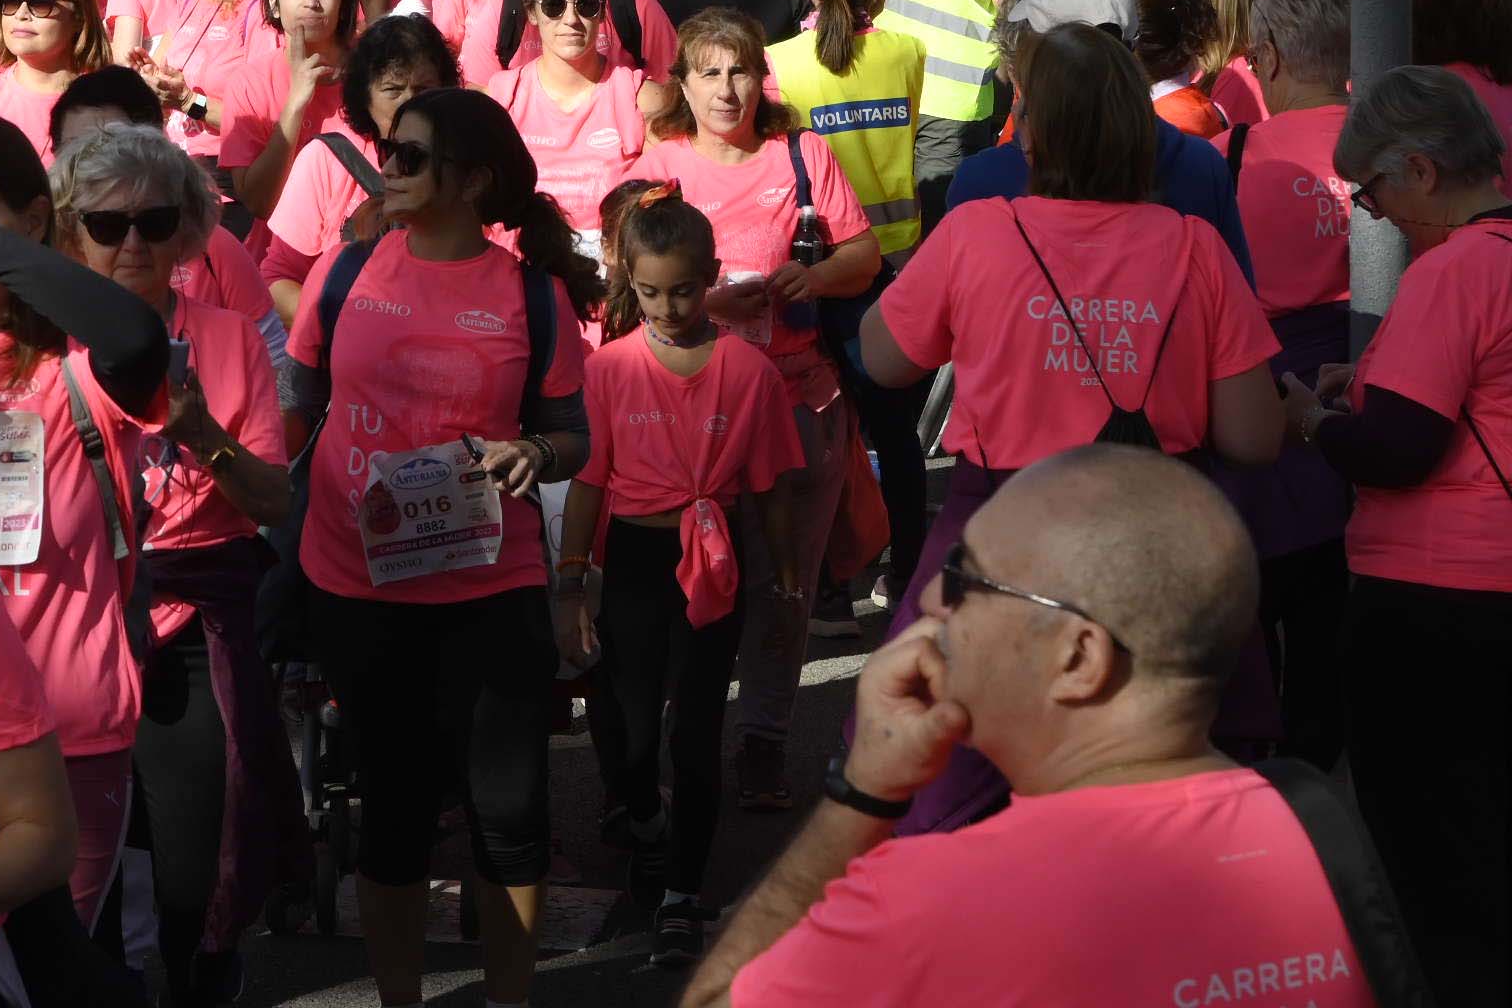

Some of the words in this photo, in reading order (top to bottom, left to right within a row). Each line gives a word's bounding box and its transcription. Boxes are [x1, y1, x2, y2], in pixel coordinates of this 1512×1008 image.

[812, 104, 908, 132] VOLUNTARIS
[354, 297, 412, 318] OYSHO
[1026, 295, 1160, 325] CARRERA
[1096, 325, 1134, 350] LA
[1043, 347, 1139, 374] MUJER
[348, 403, 383, 434] TU
[403, 495, 452, 519] 016
[416, 519, 447, 534] 8882
[1174, 952, 1349, 1006] CARRERA
